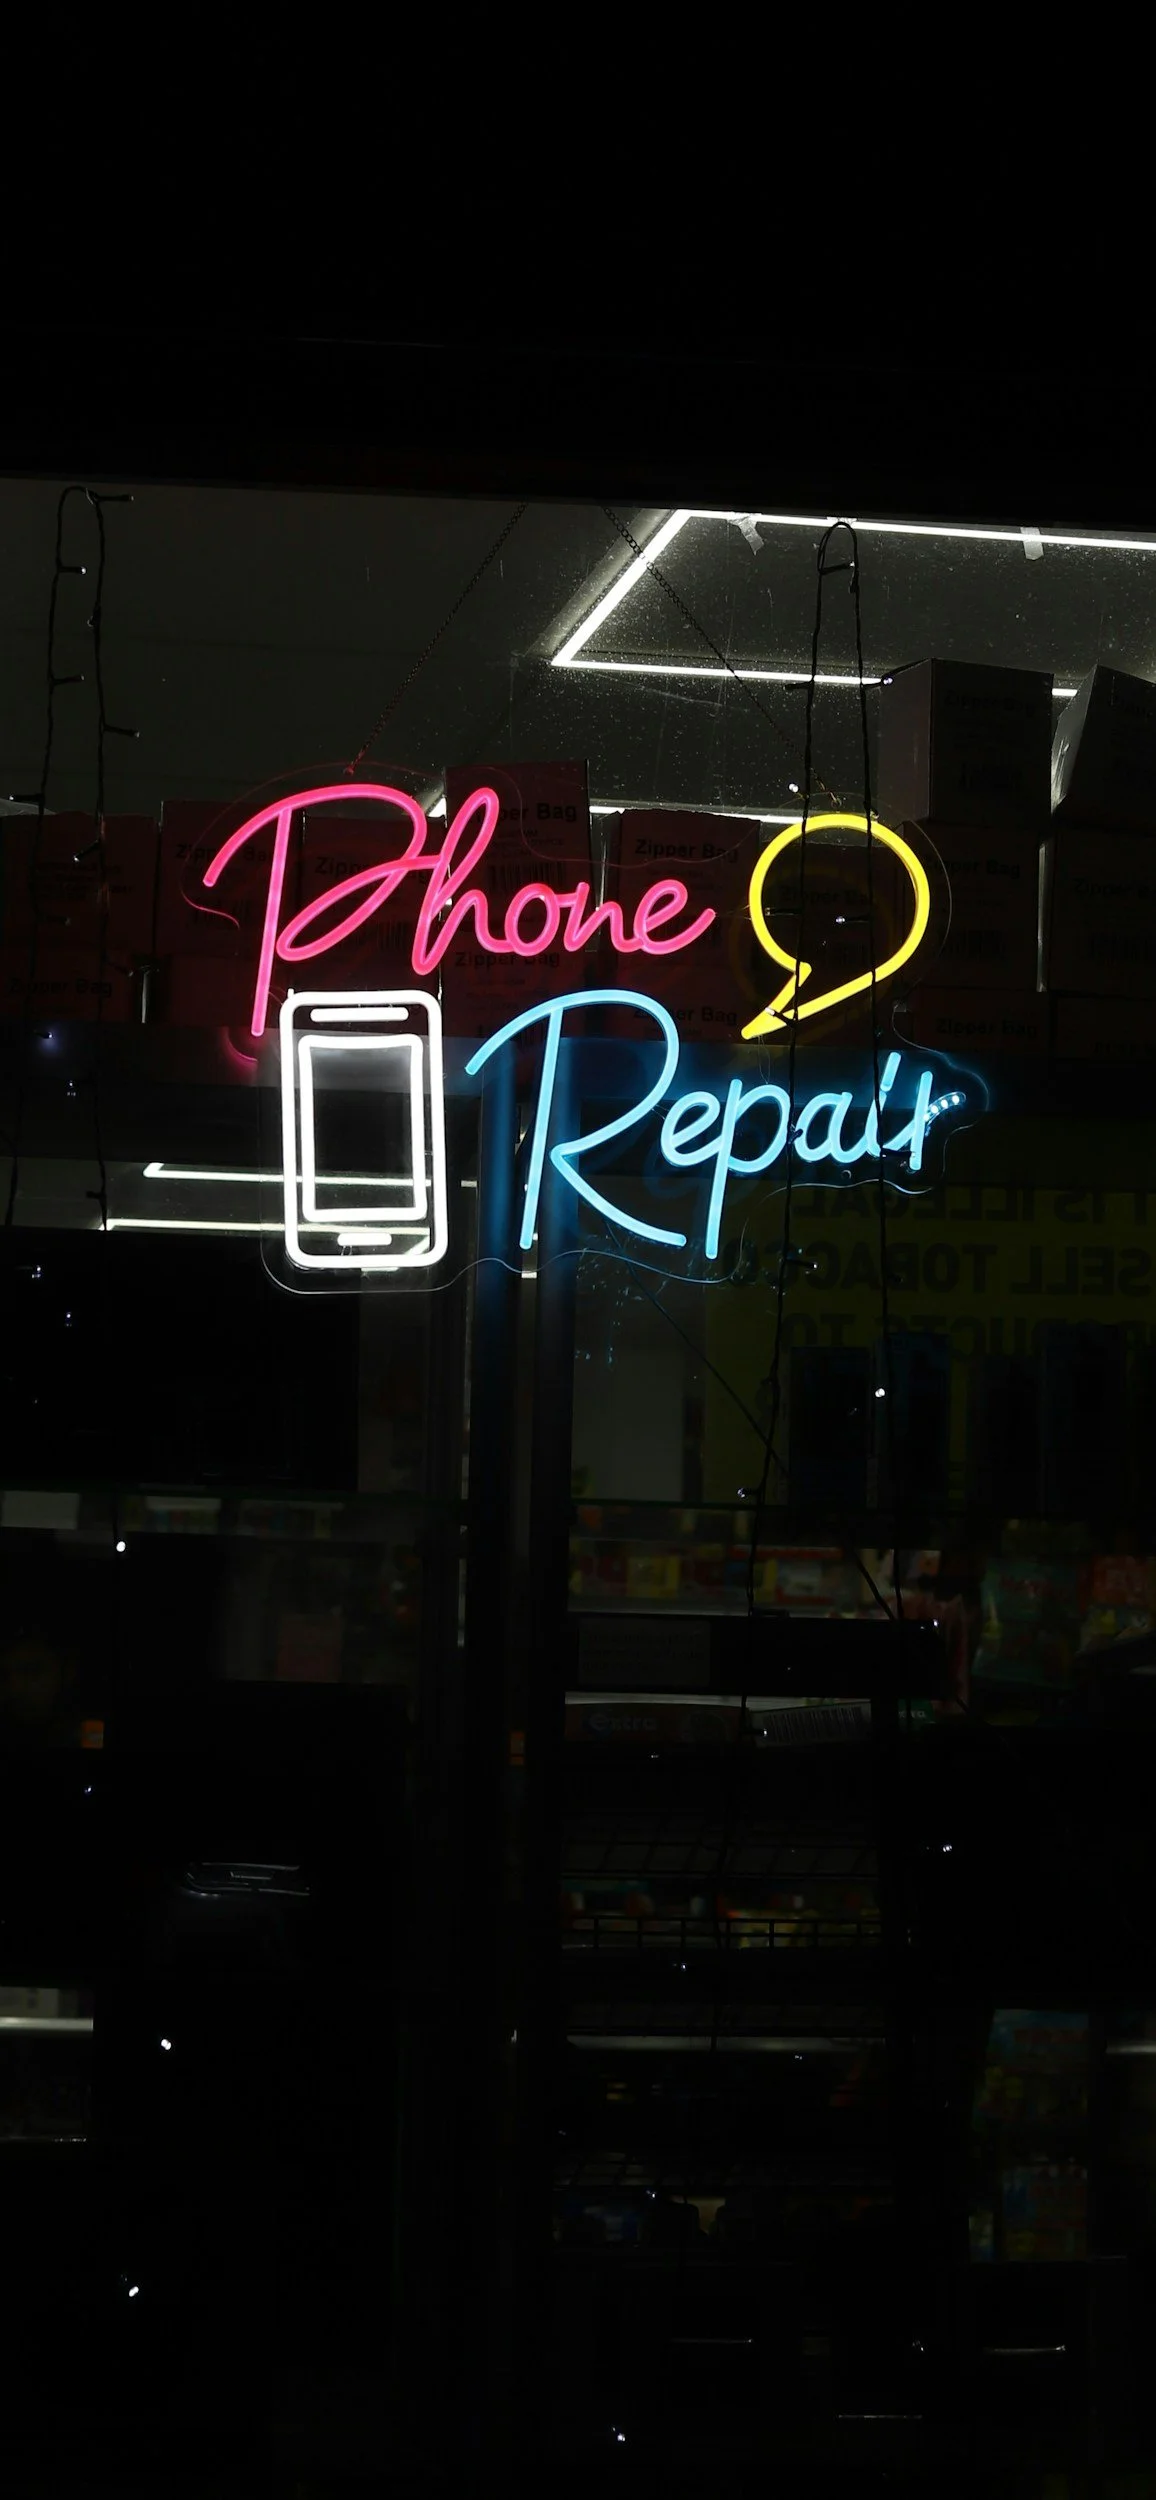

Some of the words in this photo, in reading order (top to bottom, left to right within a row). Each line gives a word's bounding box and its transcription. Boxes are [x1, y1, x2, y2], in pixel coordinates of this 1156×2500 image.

[536, 802, 577, 823] Bag
[634, 838, 697, 858] Zipper
[702, 842, 738, 864] Bag
[985, 859, 1021, 880] Bag
[201, 783, 716, 1037] Phone
[454, 950, 516, 972] Zipper
[75, 978, 112, 998] Bag
[701, 1006, 737, 1026] Bag
[935, 1017, 996, 1038] Zipper
[1002, 1019, 1038, 1040] Bag
[465, 989, 966, 1259] Repair
